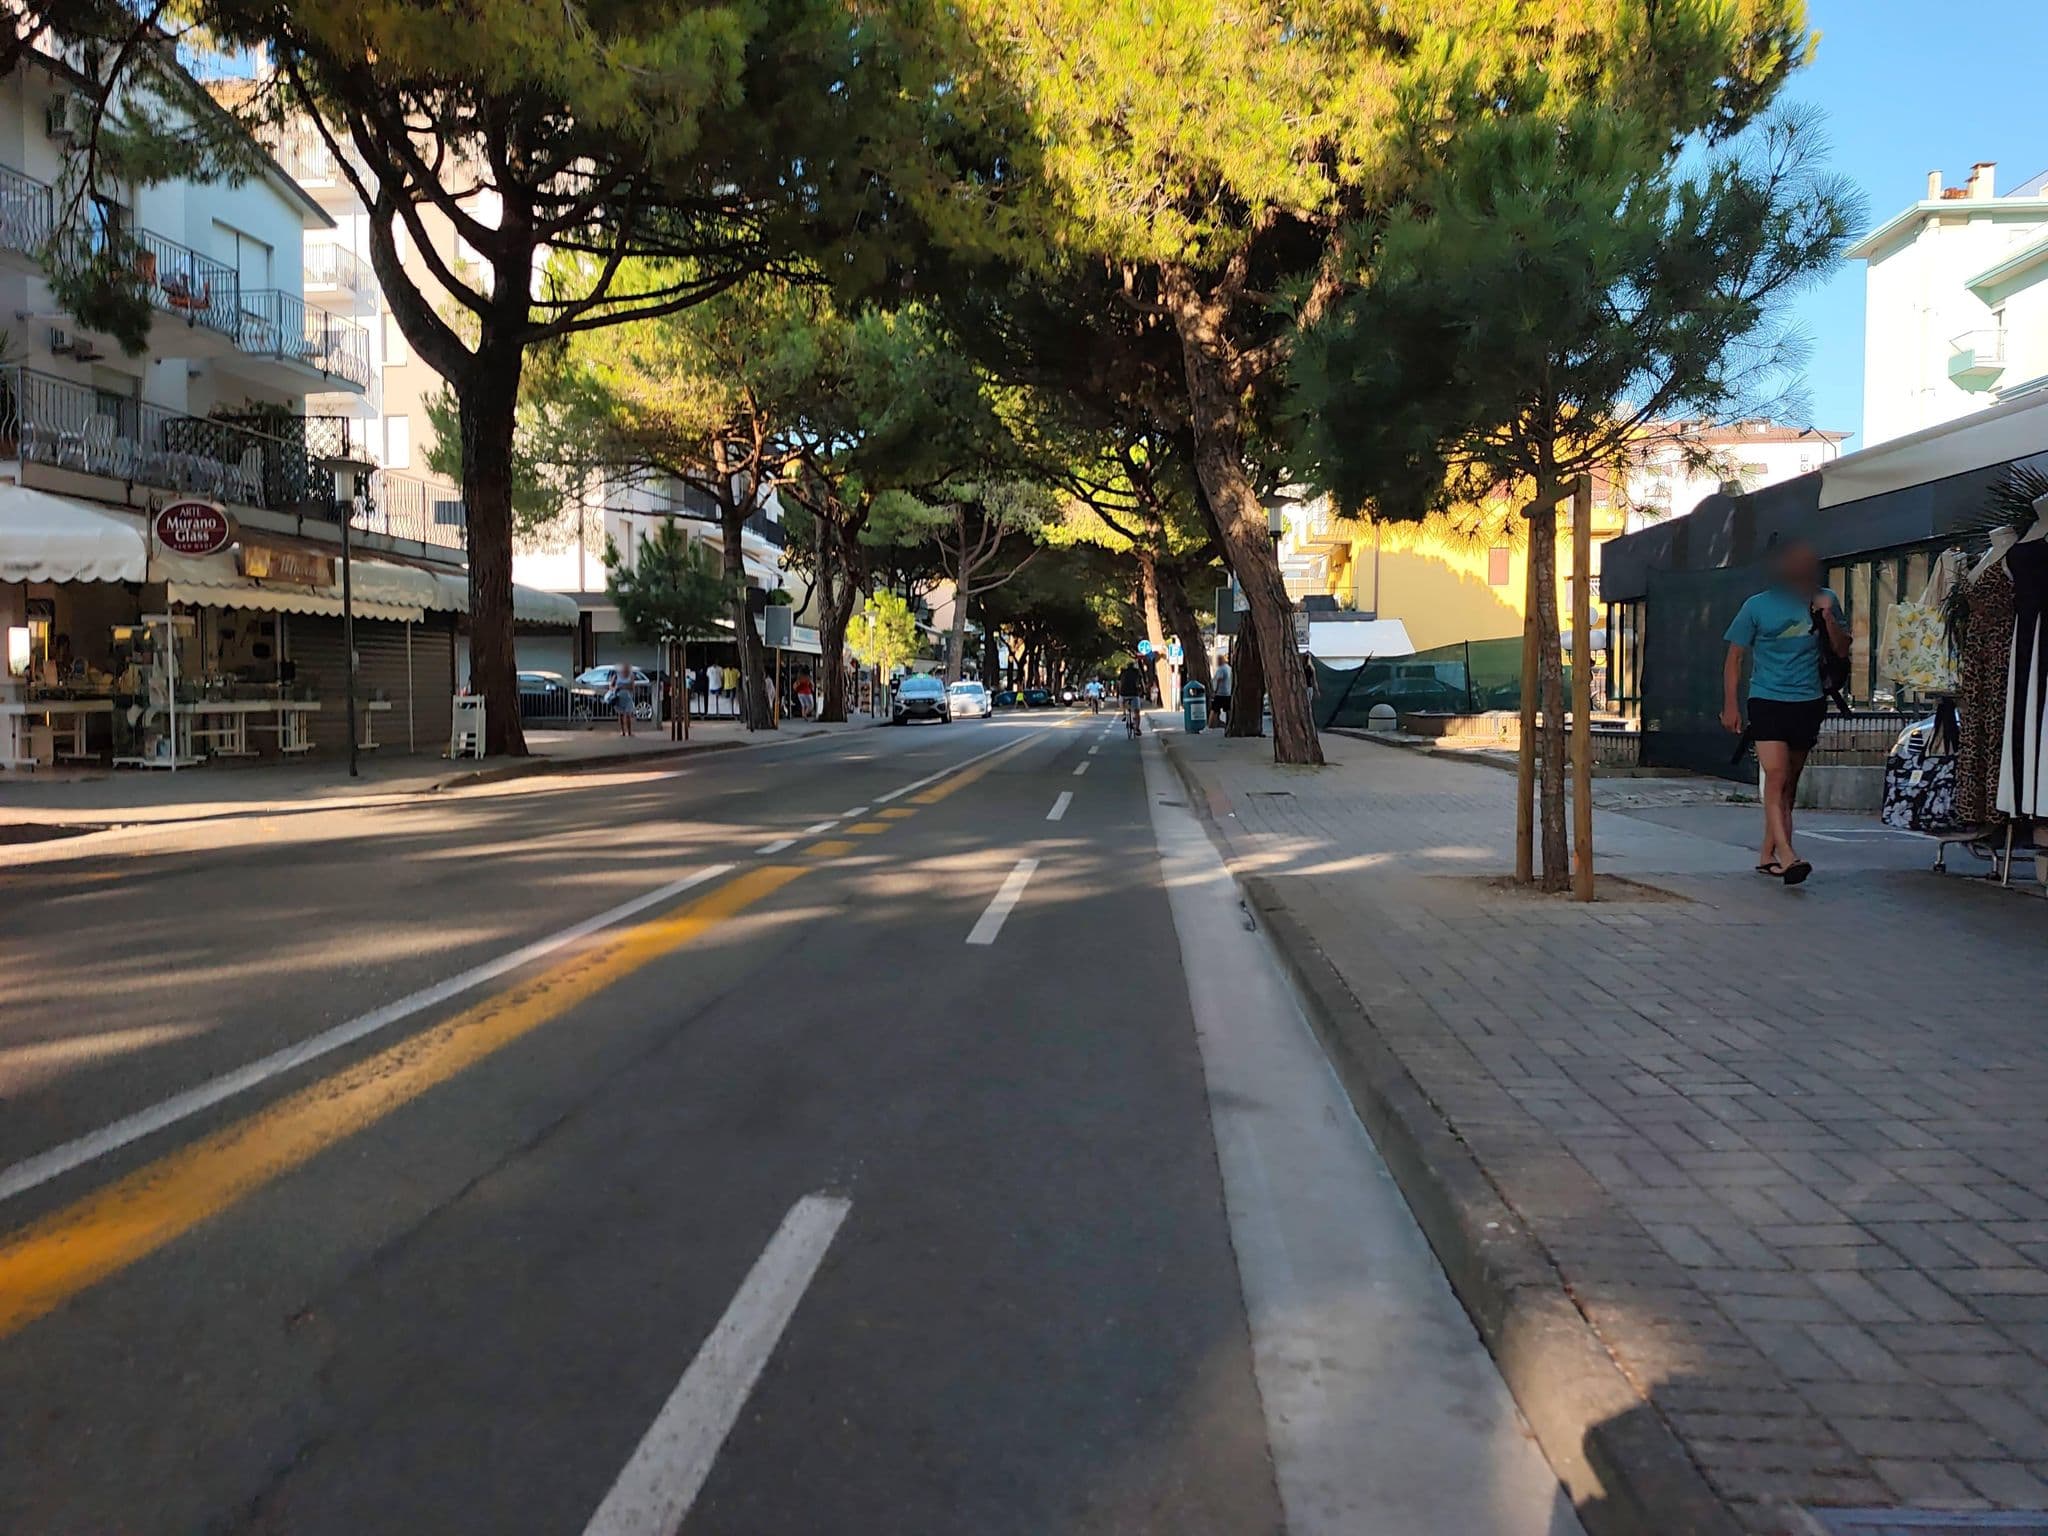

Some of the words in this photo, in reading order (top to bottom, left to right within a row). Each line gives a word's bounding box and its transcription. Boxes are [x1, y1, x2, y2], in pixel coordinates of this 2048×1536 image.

[180, 507, 200, 517] ARTE
[166, 516, 217, 530] Murano
[175, 528, 210, 543] Glass
